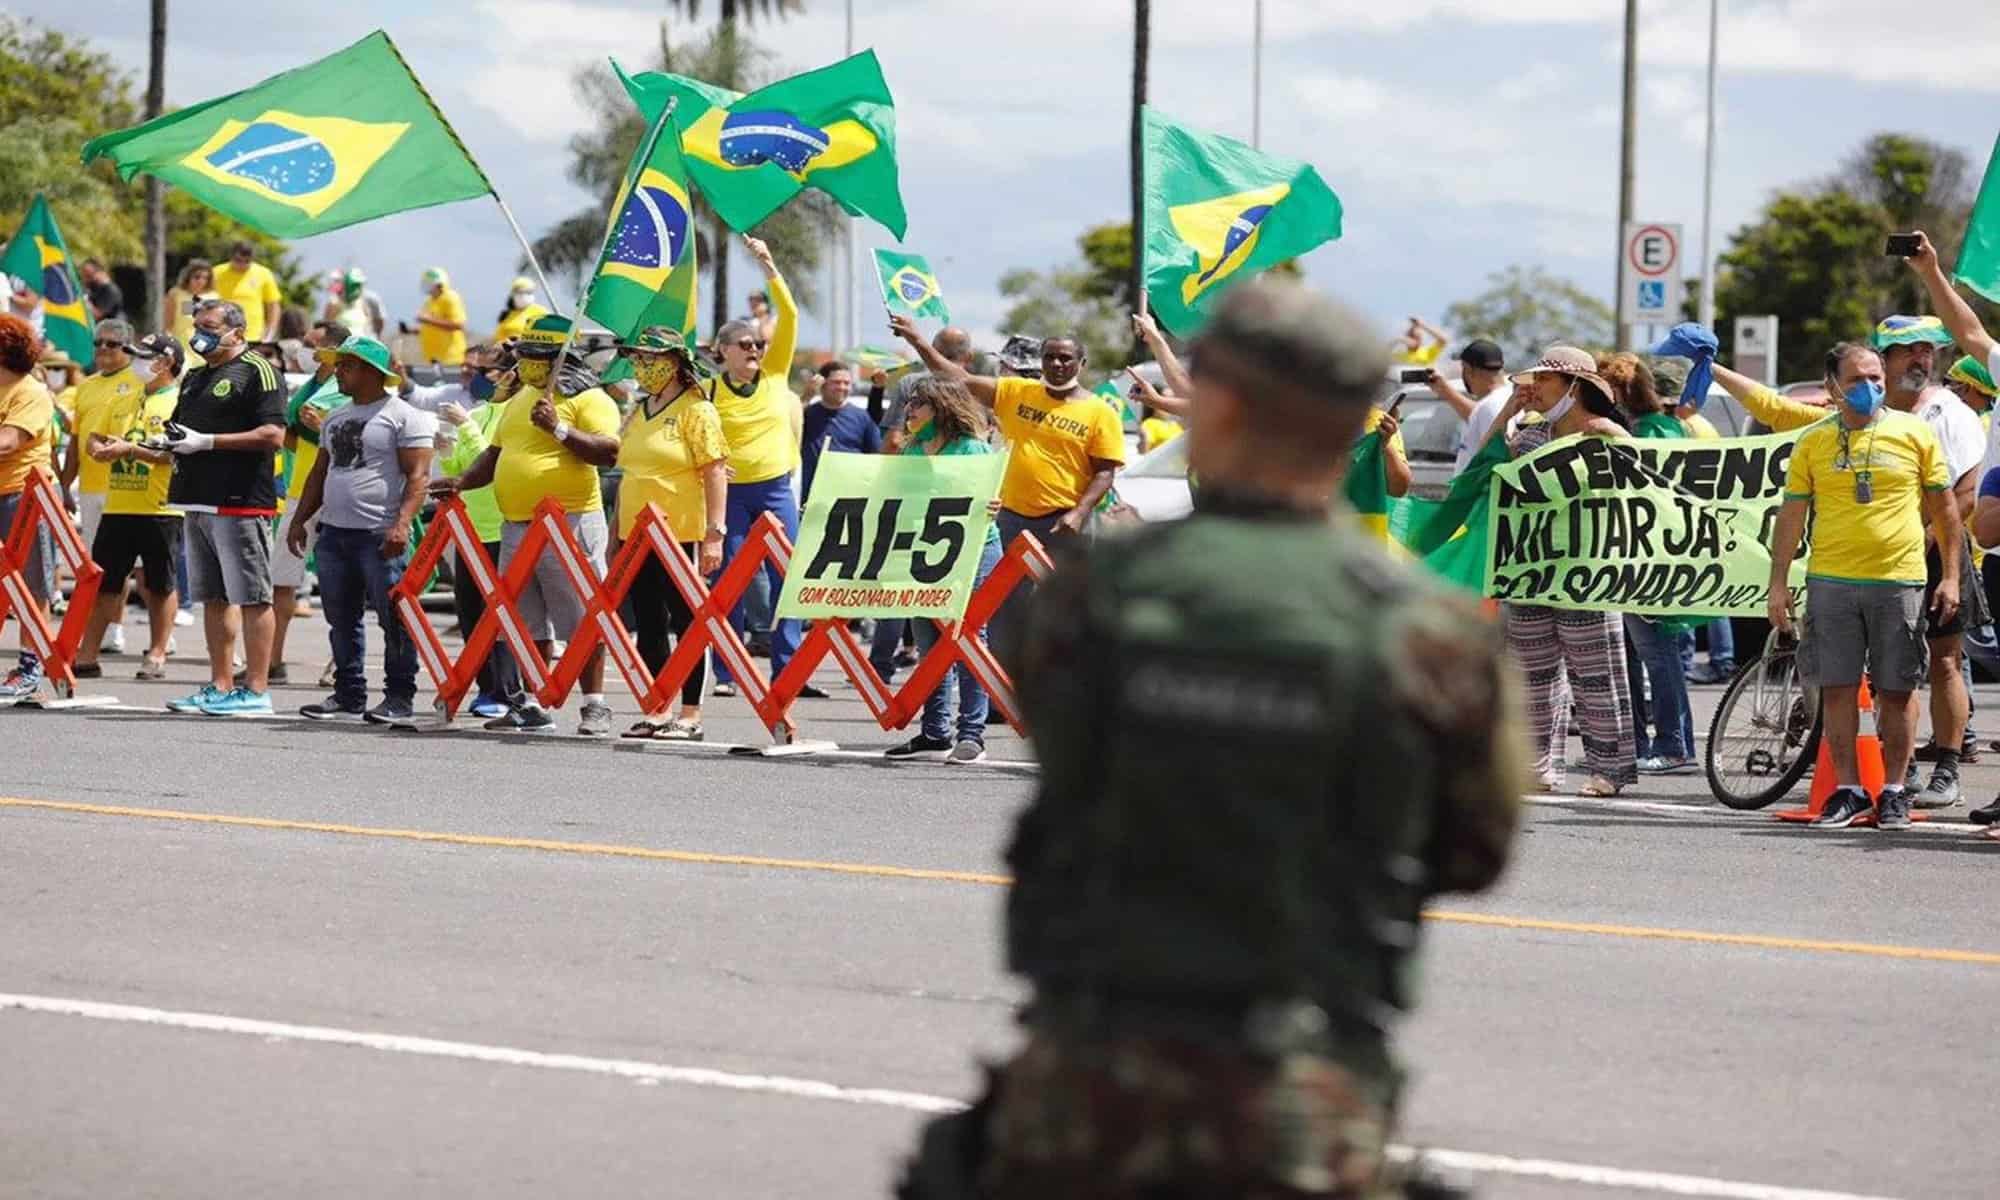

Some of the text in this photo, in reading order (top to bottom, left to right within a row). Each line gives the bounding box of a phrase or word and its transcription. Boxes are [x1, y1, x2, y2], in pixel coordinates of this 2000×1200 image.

[1643, 237, 1662, 265] E
[1016, 403, 1089, 437] NEW YORK
[804, 497, 974, 584] AI-5
[1494, 497, 1656, 572] MILITAR
[798, 587, 828, 605] COM
[826, 588, 897, 608] BOLSONARO
[913, 588, 953, 607] PODER
